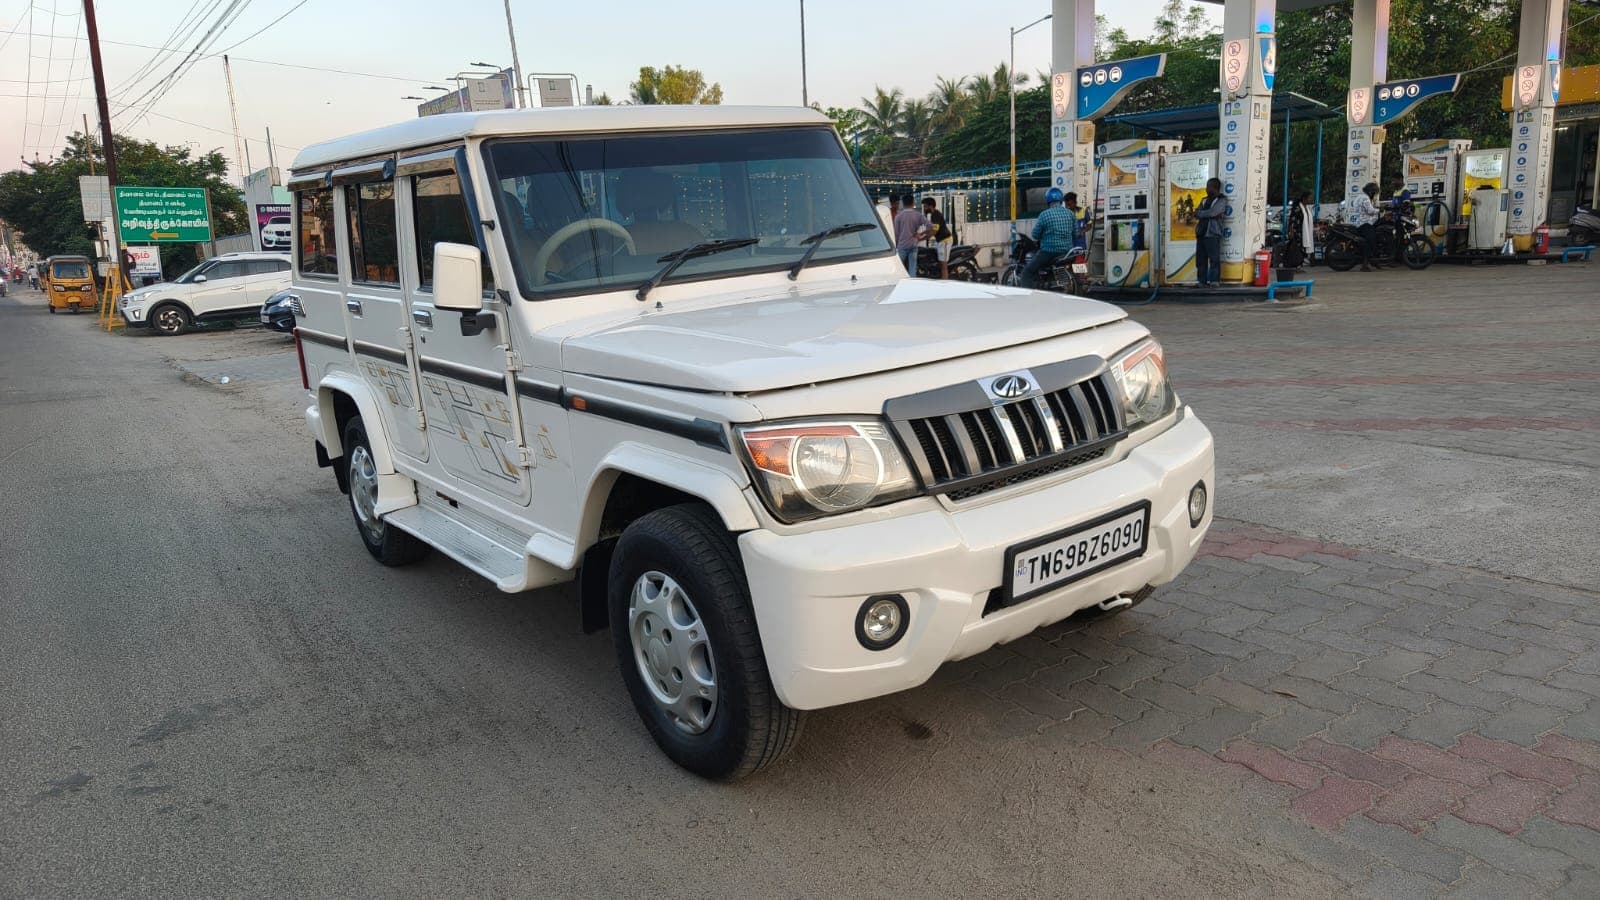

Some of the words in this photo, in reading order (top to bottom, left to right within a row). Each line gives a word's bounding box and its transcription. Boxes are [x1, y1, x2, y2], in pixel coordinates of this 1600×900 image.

[1083, 95, 1089, 108] 1
[1380, 107, 1387, 117] 3
[1027, 518, 1143, 584] TN69BZ6090
